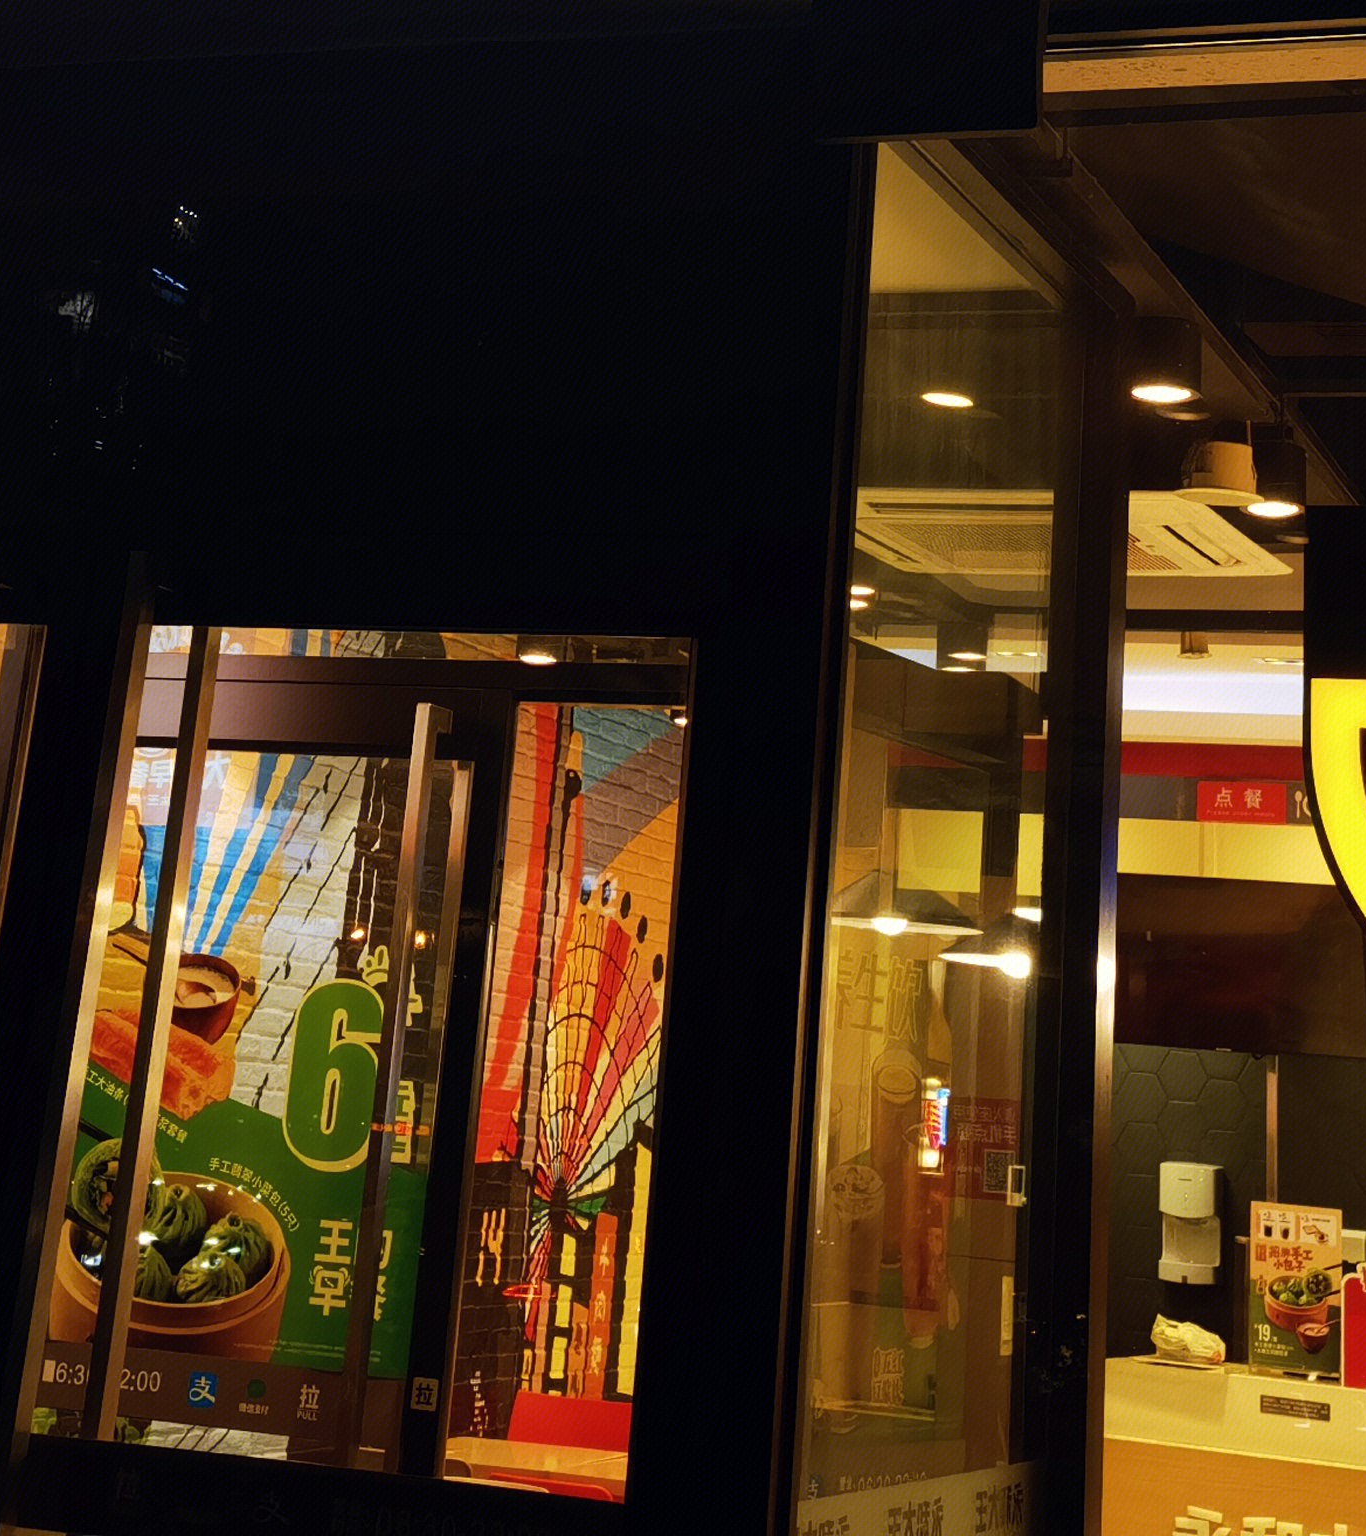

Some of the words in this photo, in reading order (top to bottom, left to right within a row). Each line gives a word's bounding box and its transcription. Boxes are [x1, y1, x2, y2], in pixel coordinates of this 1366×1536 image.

[1214, 786, 1263, 809] 点餐
[299, 1383, 321, 1410] 拉
[415, 1381, 435, 1407] 拉
[296, 1409, 319, 1422] PULL
